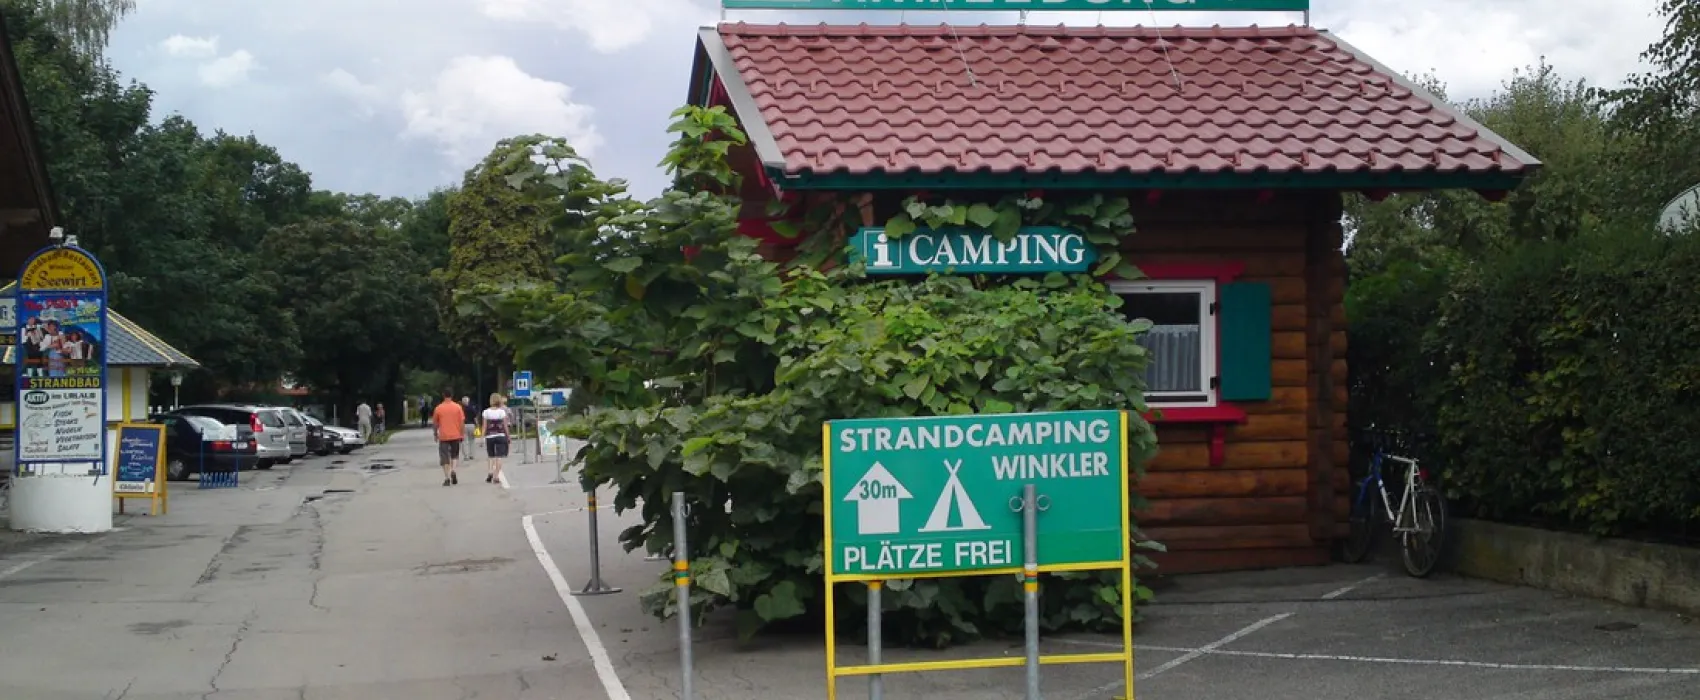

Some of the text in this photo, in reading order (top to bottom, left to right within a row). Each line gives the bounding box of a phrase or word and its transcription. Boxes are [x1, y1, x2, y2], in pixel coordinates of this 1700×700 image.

[909, 234, 1086, 266] CAMPING
[36, 270, 86, 288] Seewirt
[30, 376, 100, 389] STRANDBAD
[840, 419, 1111, 452] STRANDCAMPING
[991, 451, 1109, 481] WINKLER
[858, 479, 898, 500] 30m
[843, 540, 1012, 571] PLÄTZE FREI
